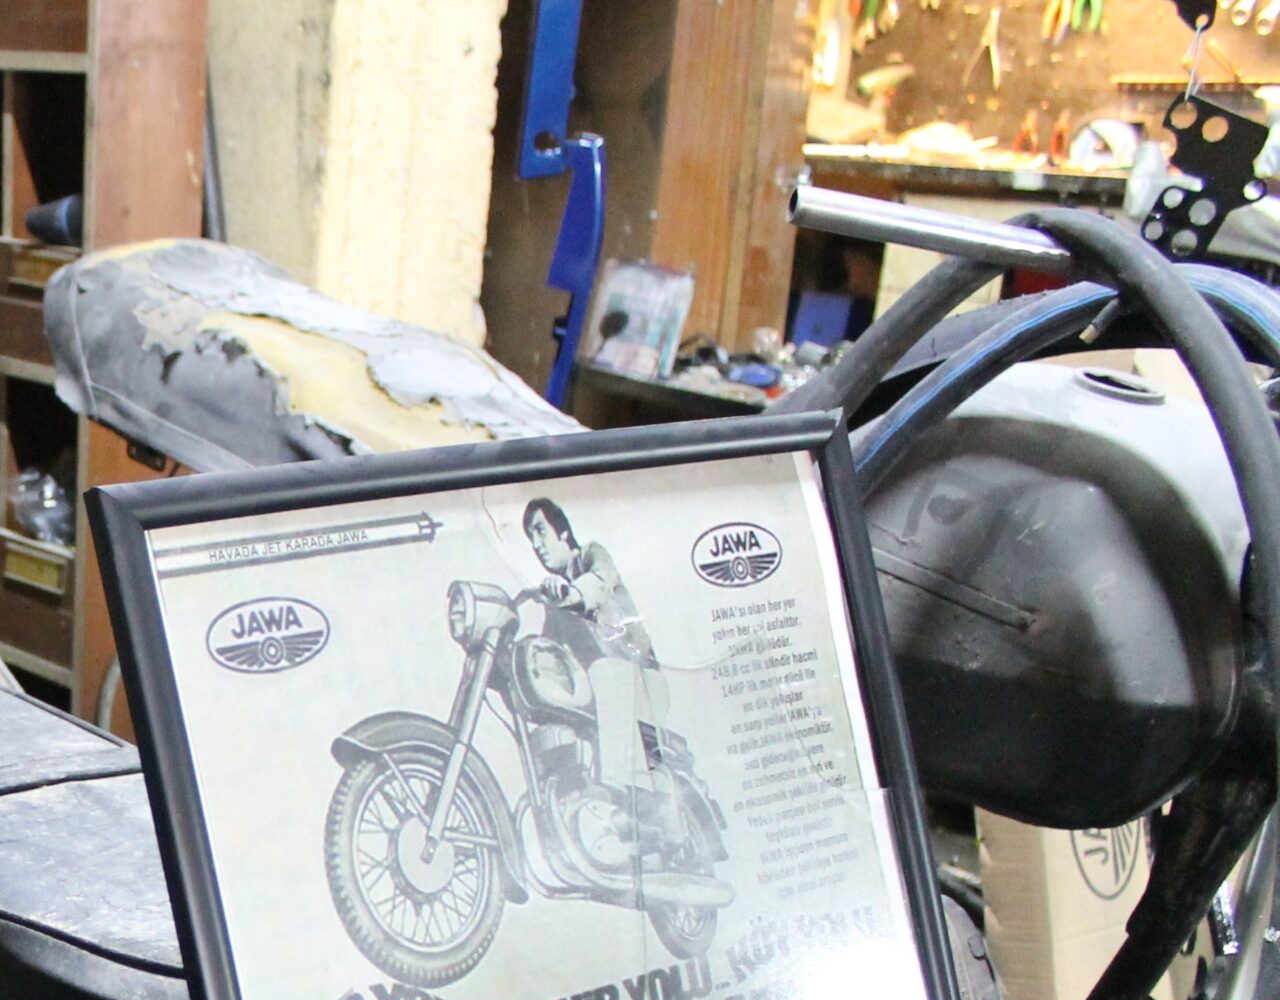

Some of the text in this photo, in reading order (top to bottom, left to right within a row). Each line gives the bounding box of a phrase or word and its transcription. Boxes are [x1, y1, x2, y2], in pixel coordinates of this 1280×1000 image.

[208, 529, 369, 563] HAVADA JET KARADA JAWA
[710, 530, 763, 558] JAWA
[747, 603, 767, 616] olan
[767, 599, 782, 612] her
[783, 598, 796, 612] yer
[230, 604, 304, 640] JAWA
[736, 625, 751, 637] her
